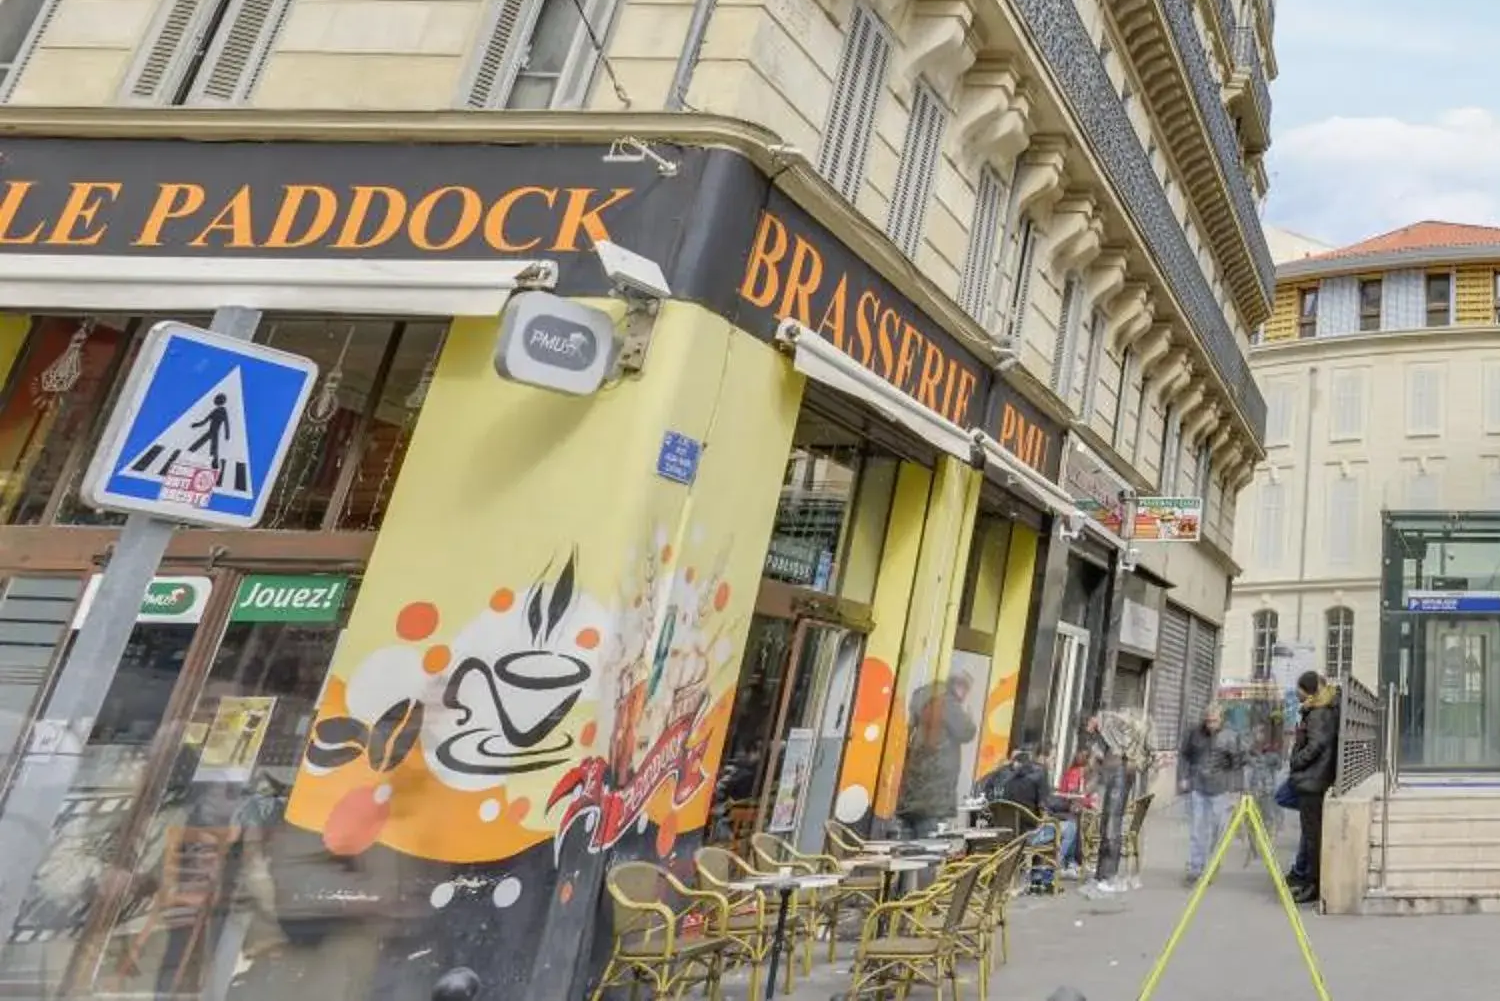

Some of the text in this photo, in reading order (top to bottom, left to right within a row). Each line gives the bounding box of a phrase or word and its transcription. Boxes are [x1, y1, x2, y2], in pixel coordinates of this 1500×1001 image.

[0, 180, 634, 251] LE PADDOCK
[530, 329, 568, 353] PMU
[739, 212, 977, 424] BRASSERIE
[1000, 403, 1049, 474] PMU
[240, 582, 339, 609] Jouez!
